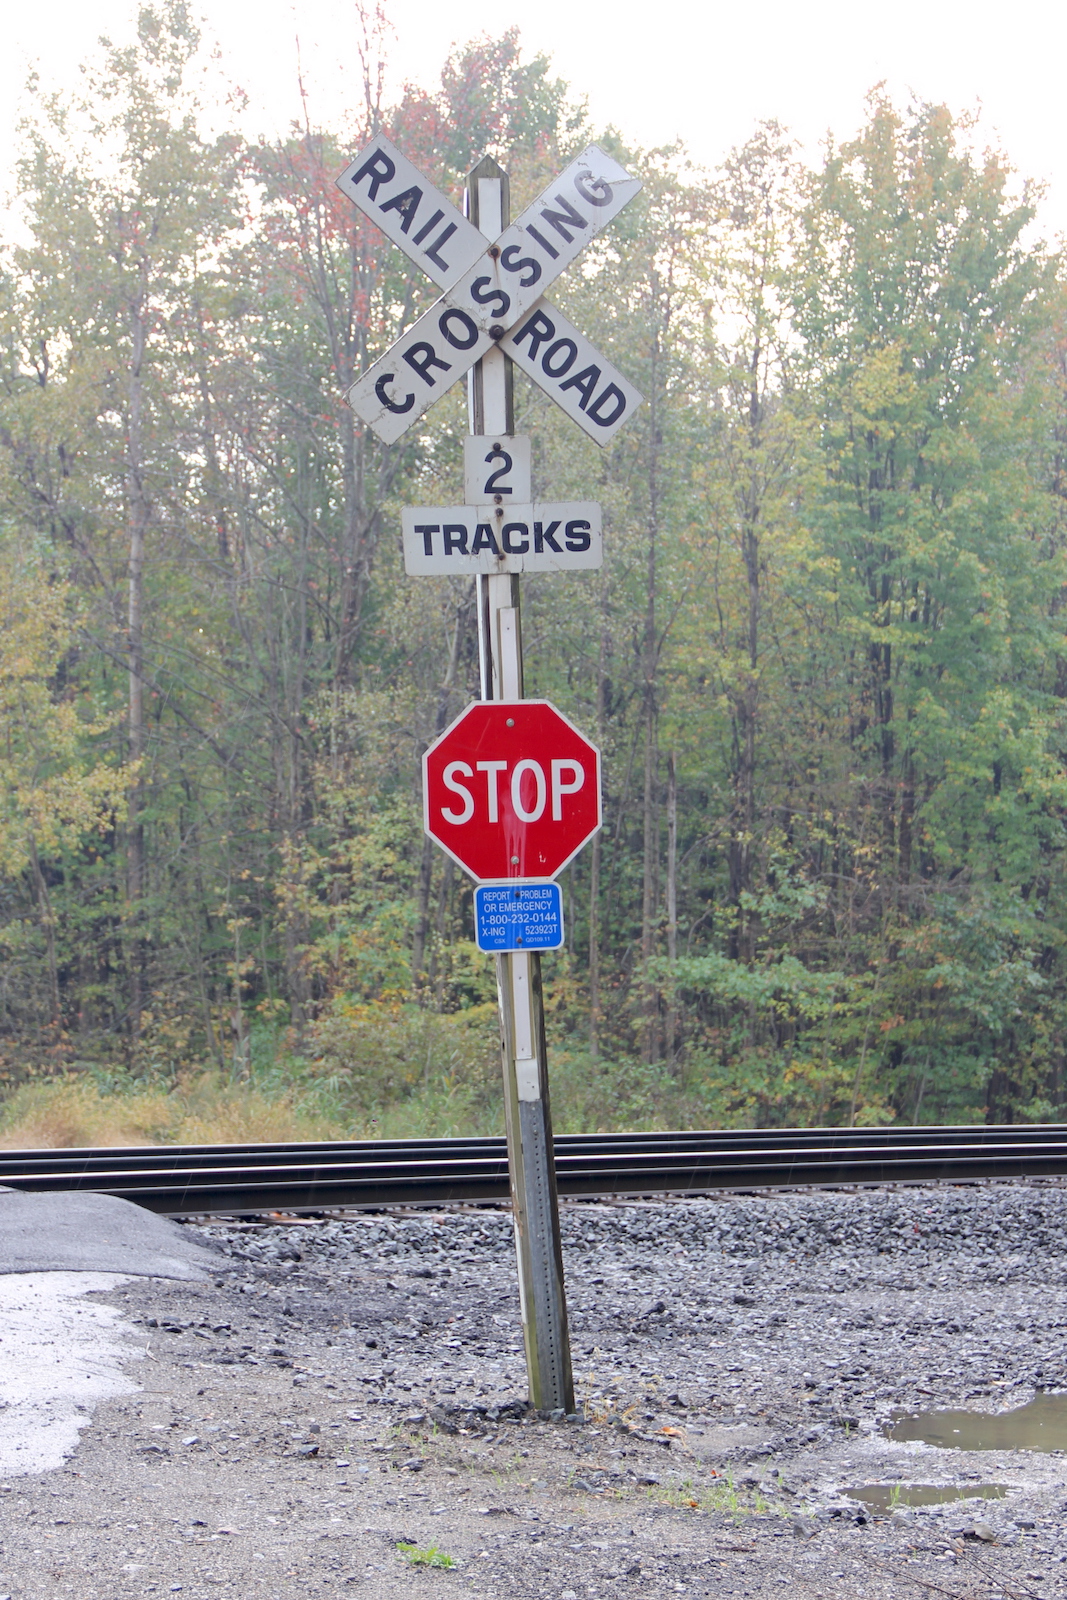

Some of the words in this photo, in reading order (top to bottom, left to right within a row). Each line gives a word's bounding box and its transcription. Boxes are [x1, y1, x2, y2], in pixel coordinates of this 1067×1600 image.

[351, 147, 458, 272] RAIL
[511, 309, 627, 427] ROAD
[374, 169, 614, 414] CROSSING
[483, 450, 513, 494] 2
[414, 520, 591, 556] TRACKS
[441, 758, 585, 825] STOP
[483, 891, 510, 901] REPORT
[519, 889, 552, 899] PROBLEM
[484, 903, 497, 913] OR
[499, 901, 552, 912] EMERGENCY
[480, 912, 557, 925] 1-800-232-0144
[482, 927, 506, 937] X-ING
[525, 924, 558, 935] 523923T
